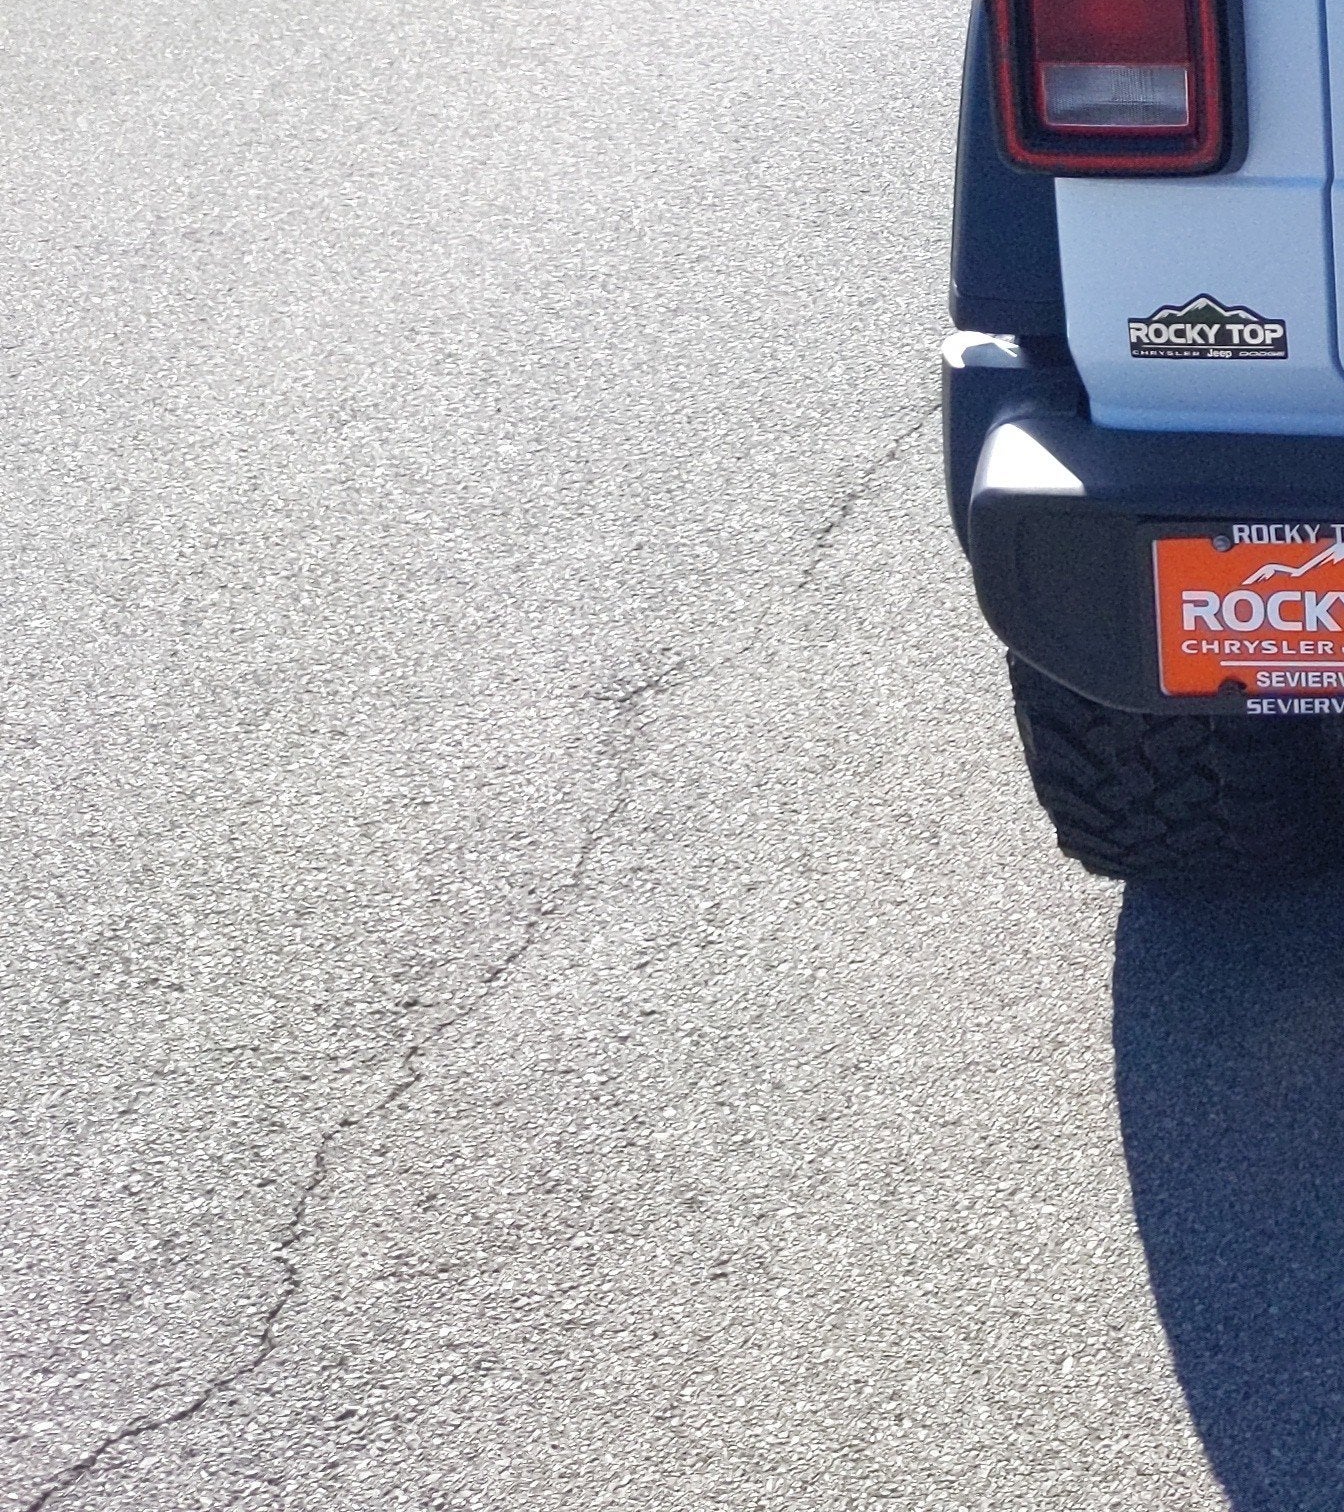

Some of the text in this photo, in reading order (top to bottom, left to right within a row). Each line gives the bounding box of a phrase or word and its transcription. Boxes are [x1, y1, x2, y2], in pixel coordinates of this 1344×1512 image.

[1129, 322, 1284, 344] ROCKY TOP
[1207, 348, 1232, 358] Jeep
[1232, 524, 1320, 544] ROCKY
[1181, 639, 1333, 655] CHRYSLER
